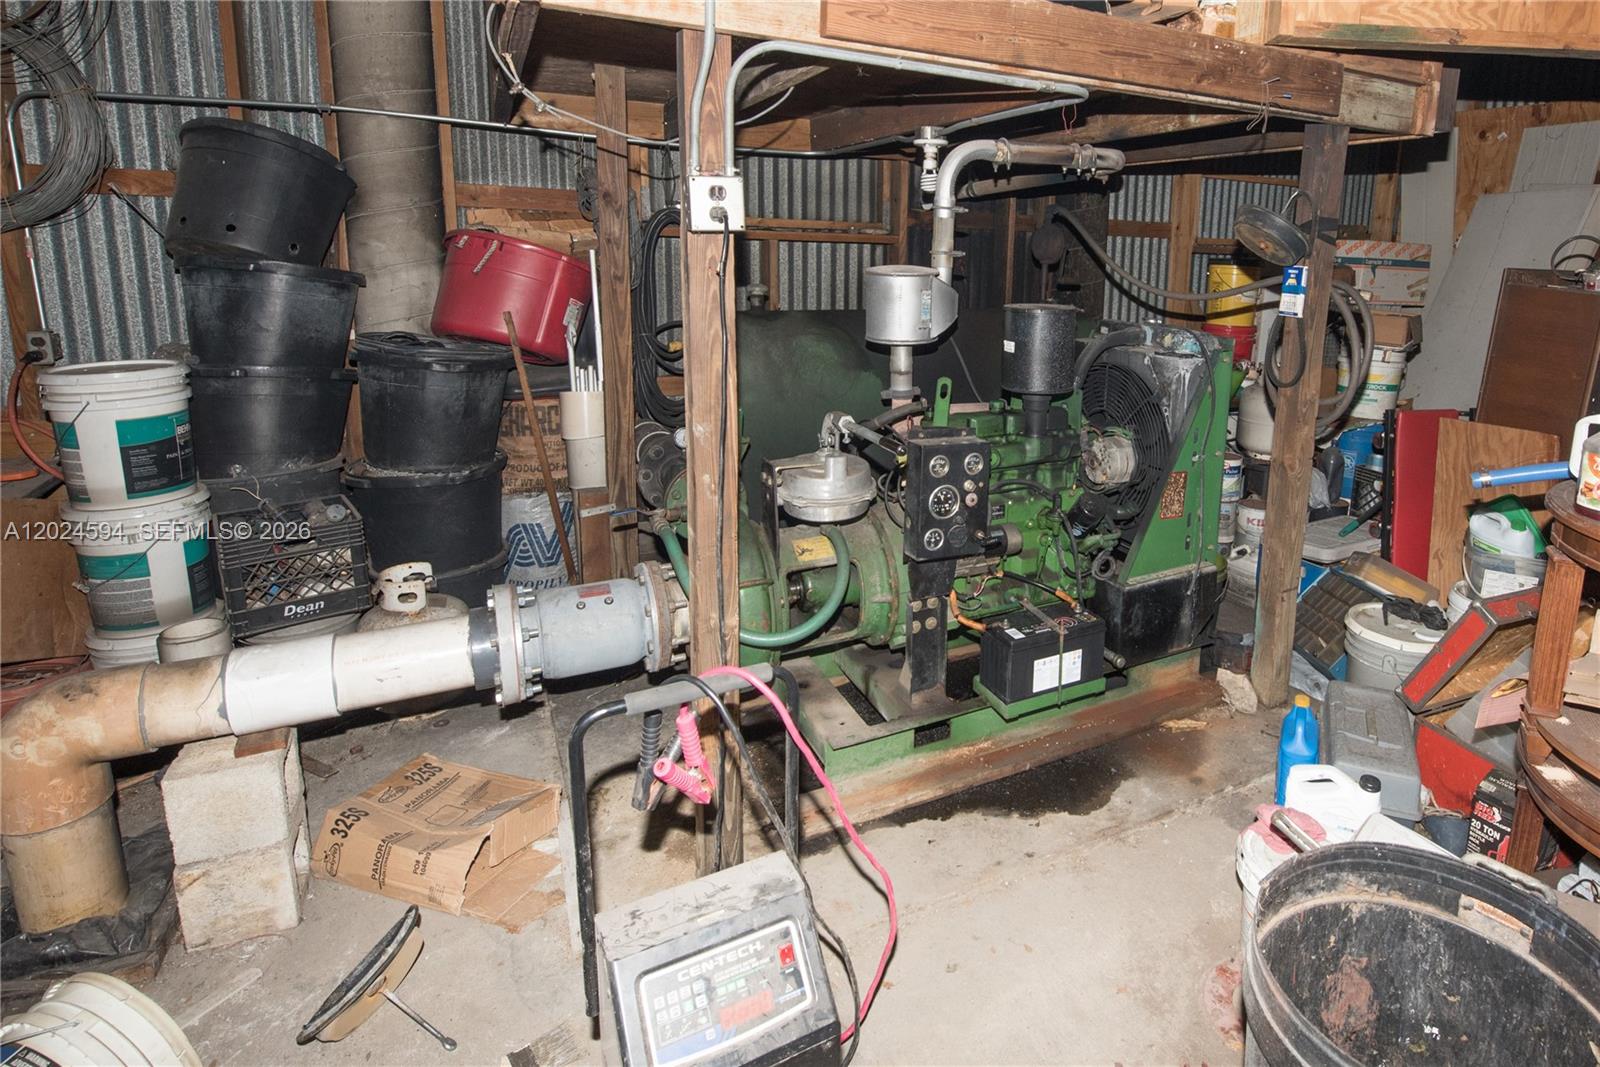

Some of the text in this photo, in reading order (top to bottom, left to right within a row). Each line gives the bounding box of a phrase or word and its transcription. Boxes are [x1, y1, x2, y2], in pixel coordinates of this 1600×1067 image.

[283, 601, 325, 617] Dean
[405, 762, 443, 787] 325S
[330, 807, 370, 839] 325S
[1471, 818, 1501, 842] 20 TON
